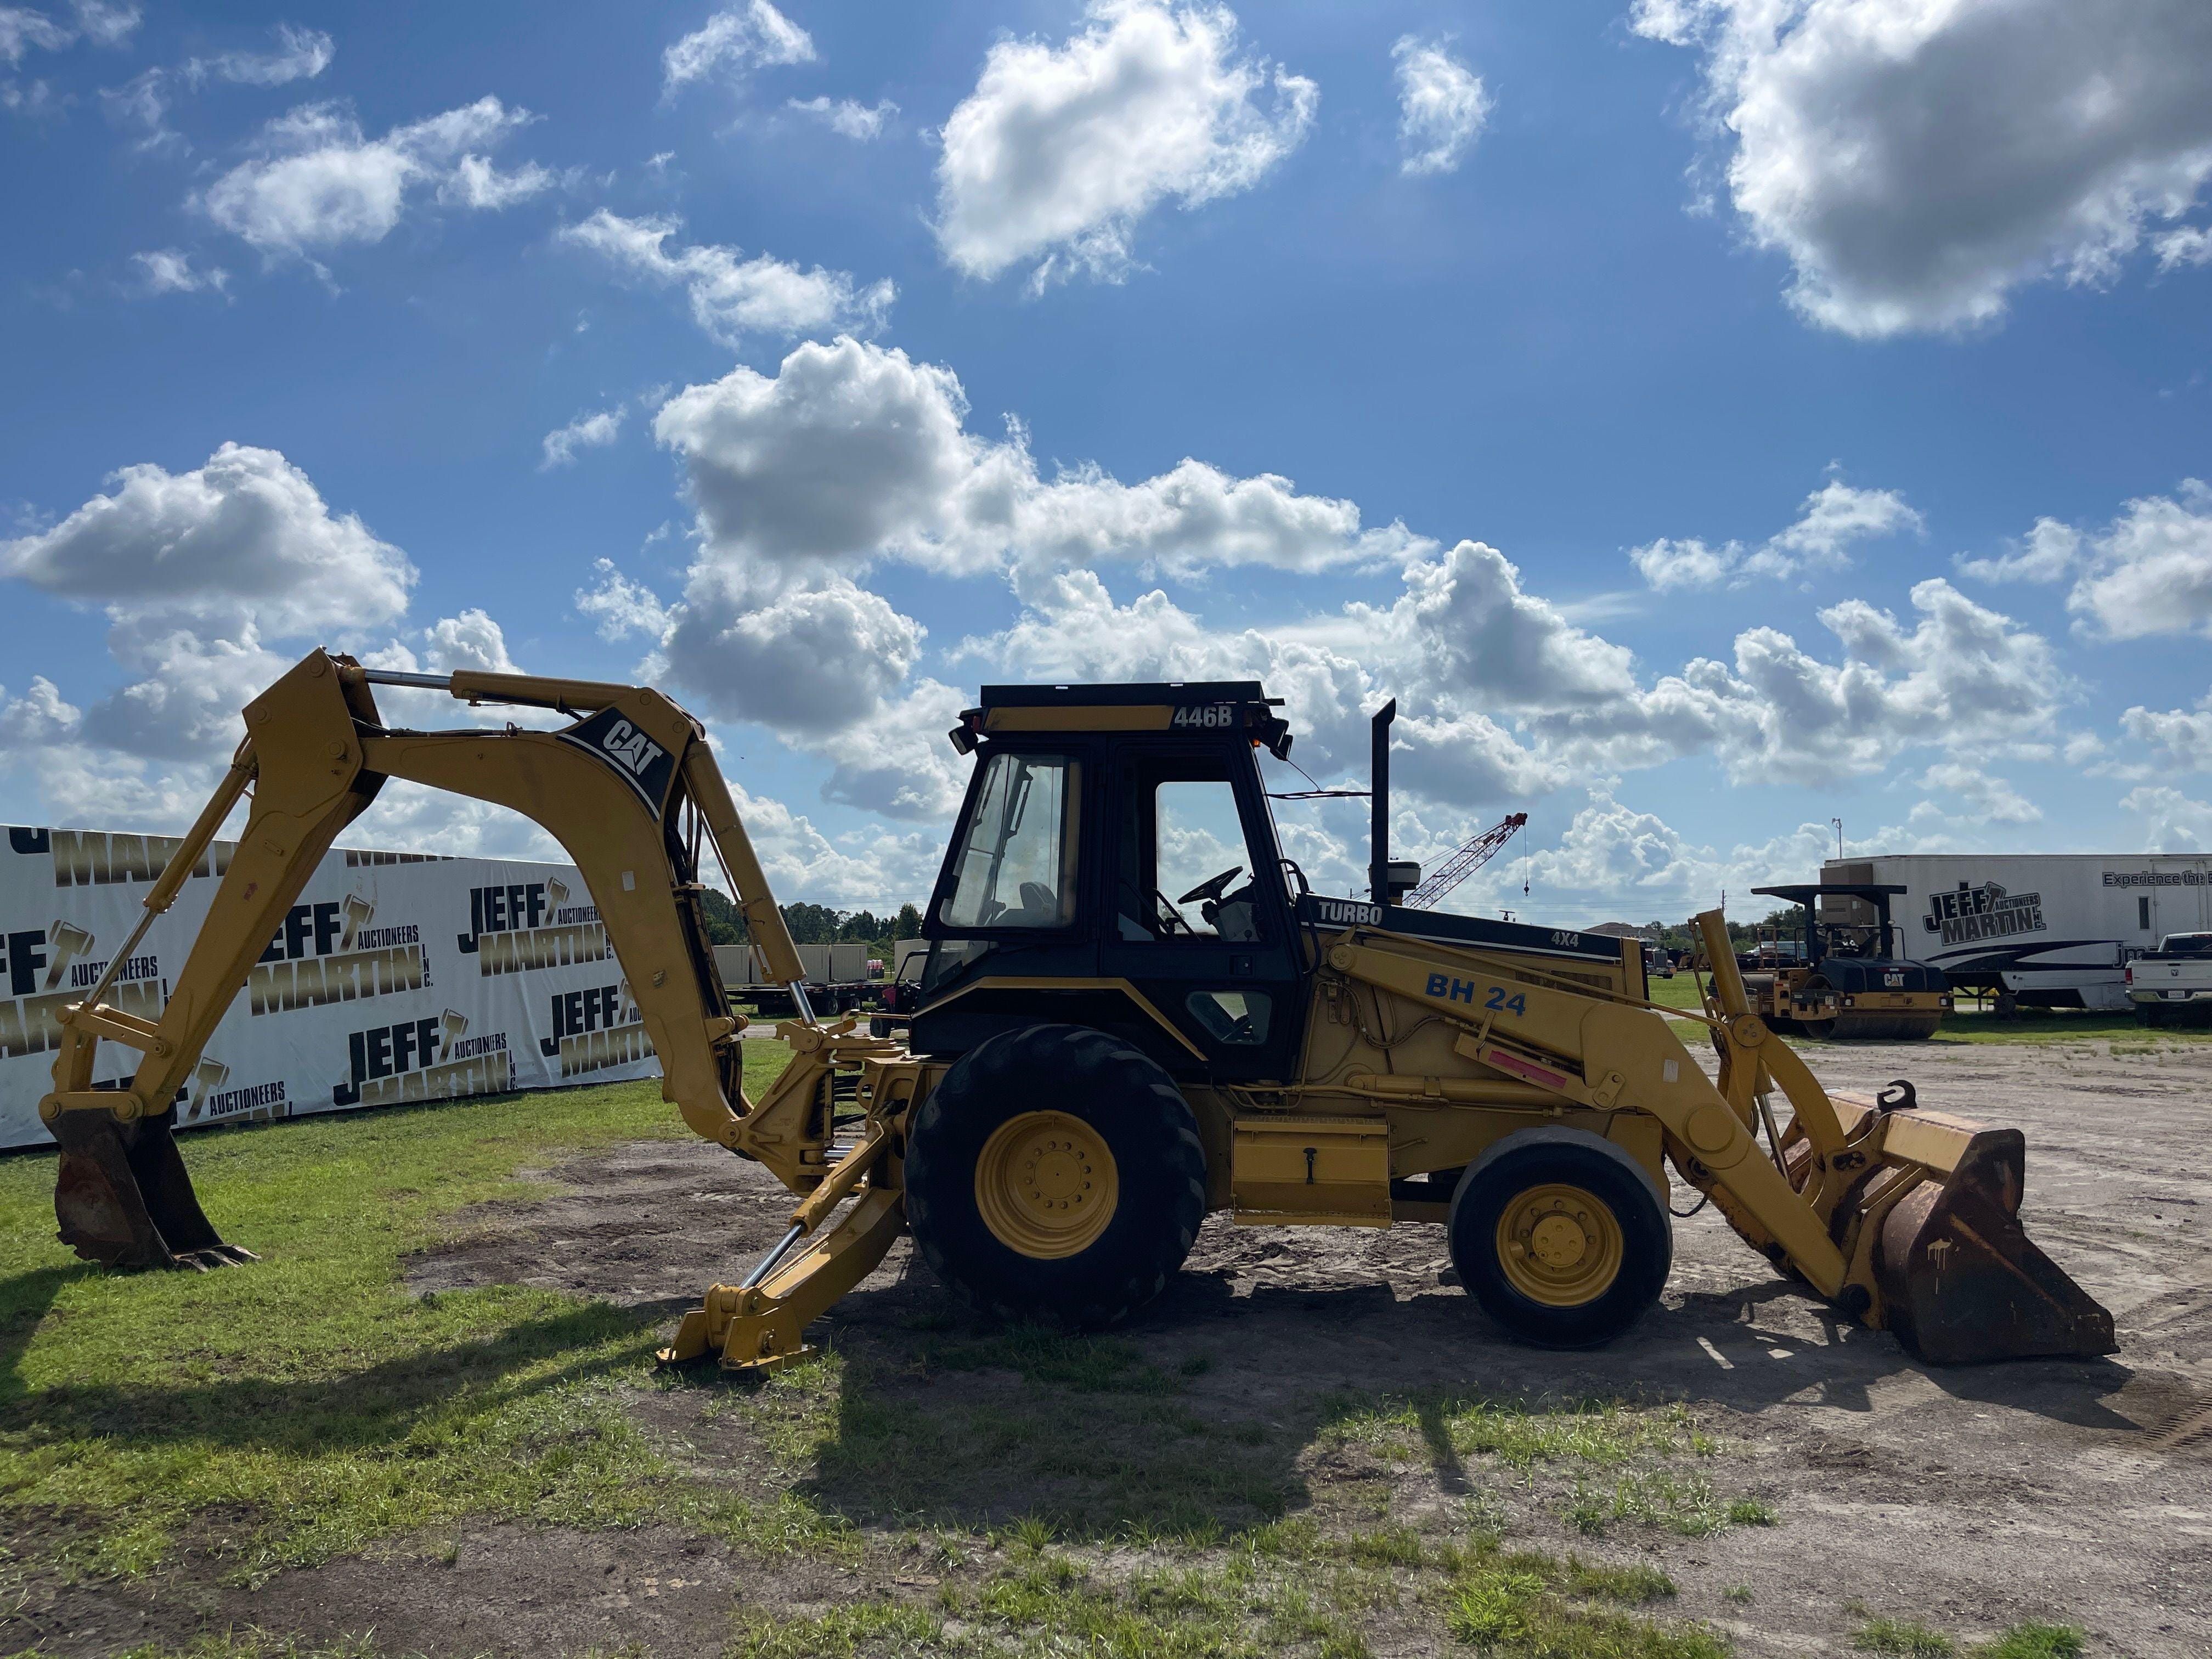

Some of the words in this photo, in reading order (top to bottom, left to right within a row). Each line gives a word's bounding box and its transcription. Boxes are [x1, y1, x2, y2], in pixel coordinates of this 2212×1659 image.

[1174, 706, 1232, 727] 446B
[603, 719, 663, 775] CAT
[2103, 872, 2180, 888] Experience
[2183, 871, 2205, 885] the
[457, 883, 545, 954] JEFF
[558, 905, 602, 925] AUCTIONEER
[1318, 901, 1383, 926] TURBO
[1925, 889, 1989, 931] JEFF
[1995, 895, 2039, 910] AUCTIONEERS
[258, 901, 341, 963] EFF
[358, 924, 419, 950] AUCTIONEERS
[1551, 932, 1579, 947] 4X4
[1941, 907, 2033, 944] MARTIN
[479, 922, 605, 978] MARTIN
[605, 929, 614, 960] NC.
[71, 956, 158, 988] AUCTNEERS
[250, 945, 422, 1017] MARTIN
[422, 943, 434, 987] INC.
[1883, 973, 1905, 986] CAT
[1425, 973, 1475, 1004] BH
[1484, 987, 1527, 1017] 24
[539, 985, 619, 1057] JEFF
[332, 1017, 440, 1107] JEFF
[561, 1023, 658, 1079] MARTI
[210, 1081, 285, 1116] AUCTIONEERS
